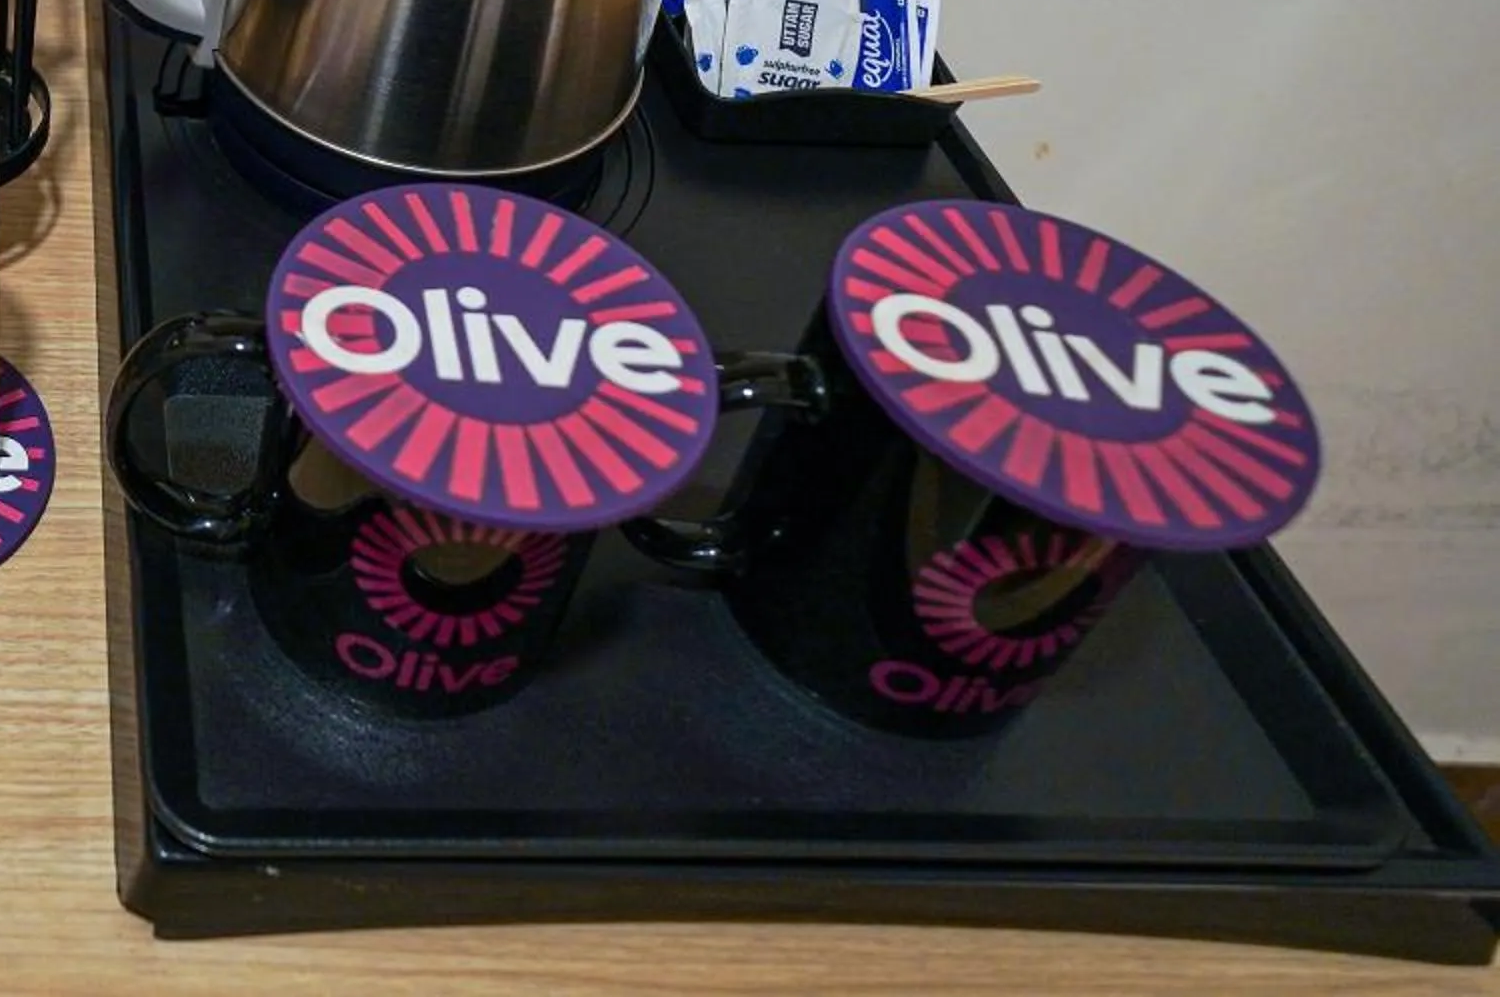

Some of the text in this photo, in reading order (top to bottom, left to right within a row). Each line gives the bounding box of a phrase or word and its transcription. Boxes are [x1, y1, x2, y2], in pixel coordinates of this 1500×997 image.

[782, 1, 801, 47] UTTAM
[797, 3, 817, 49] SUGAR
[301, 285, 683, 395] Olive
[871, 293, 1278, 426] Olive
[335, 632, 519, 692] Olive
